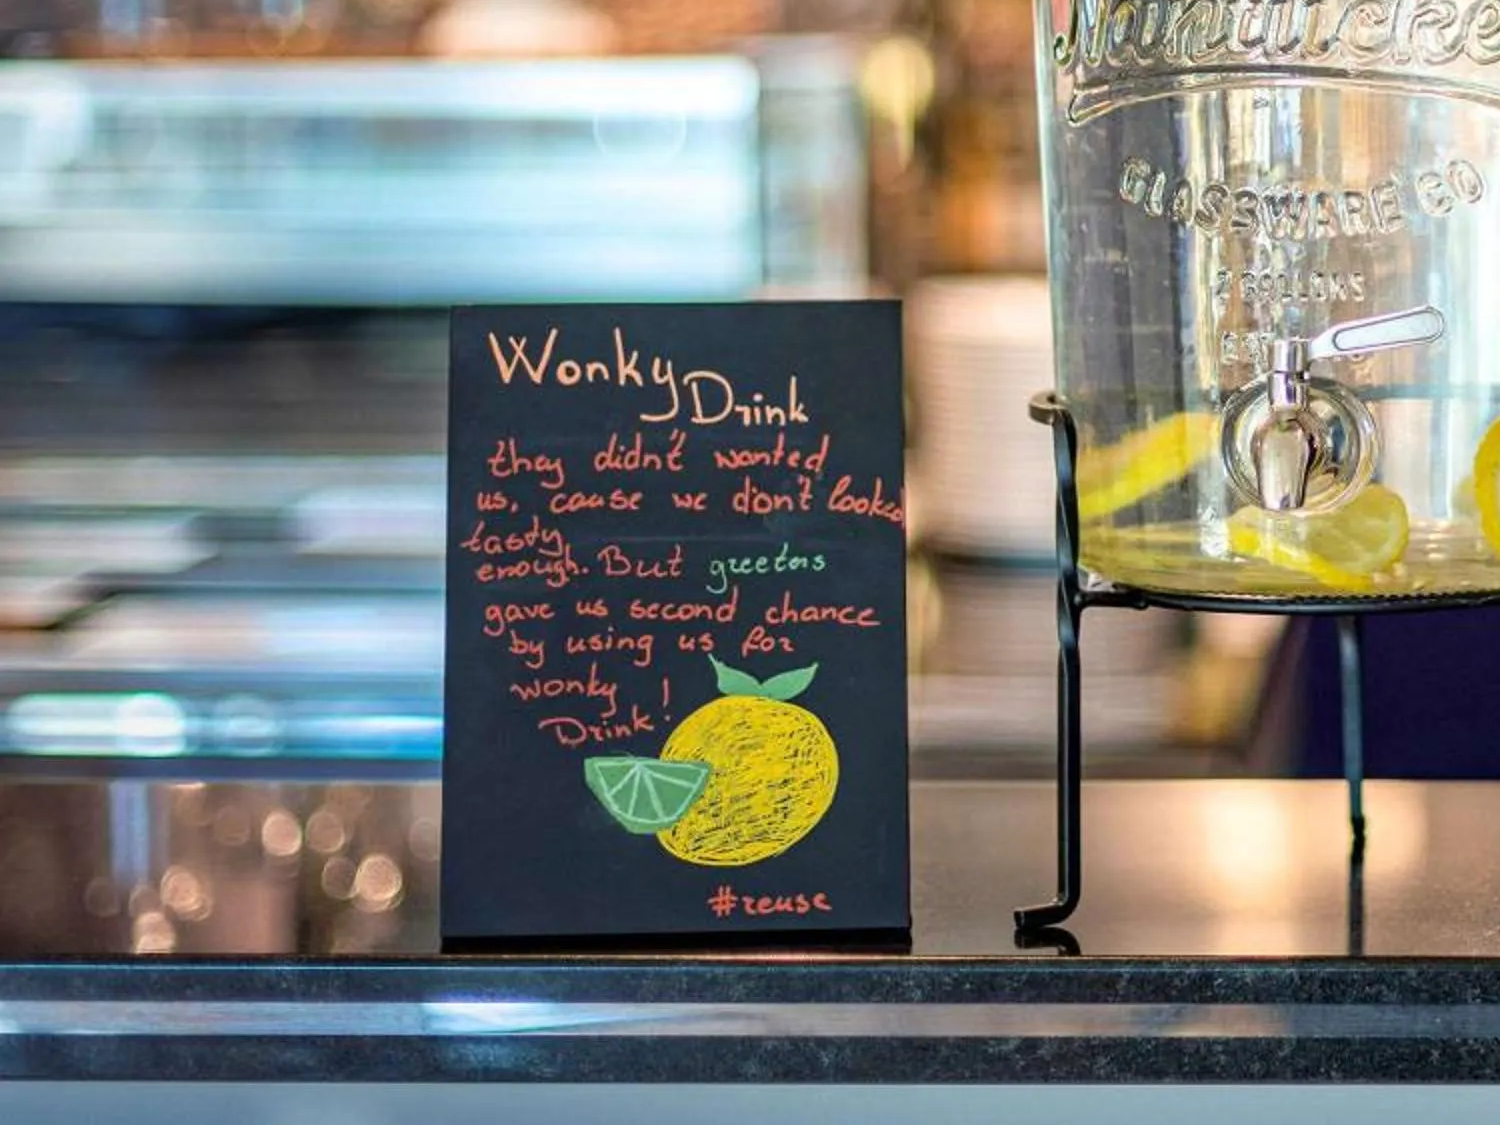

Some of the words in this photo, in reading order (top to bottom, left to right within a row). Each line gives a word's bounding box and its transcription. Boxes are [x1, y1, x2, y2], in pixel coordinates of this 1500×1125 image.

[1119, 155, 1405, 242] GLASSWARE
[487, 326, 680, 423] Wonky
[683, 370, 810, 426] Drink
[714, 431, 830, 474] wanted
[550, 487, 643, 515] cause
[672, 491, 708, 512] we
[597, 543, 684, 578] But
[483, 602, 556, 637] gave
[575, 598, 609, 618] us
[629, 585, 739, 623] second
[764, 590, 881, 627] chance
[508, 628, 546, 670] by
[566, 625, 655, 668] using
[677, 631, 716, 653] us
[741, 624, 795, 659] for
[508, 660, 618, 719] wonky
[706, 884, 833, 919] #reuse
